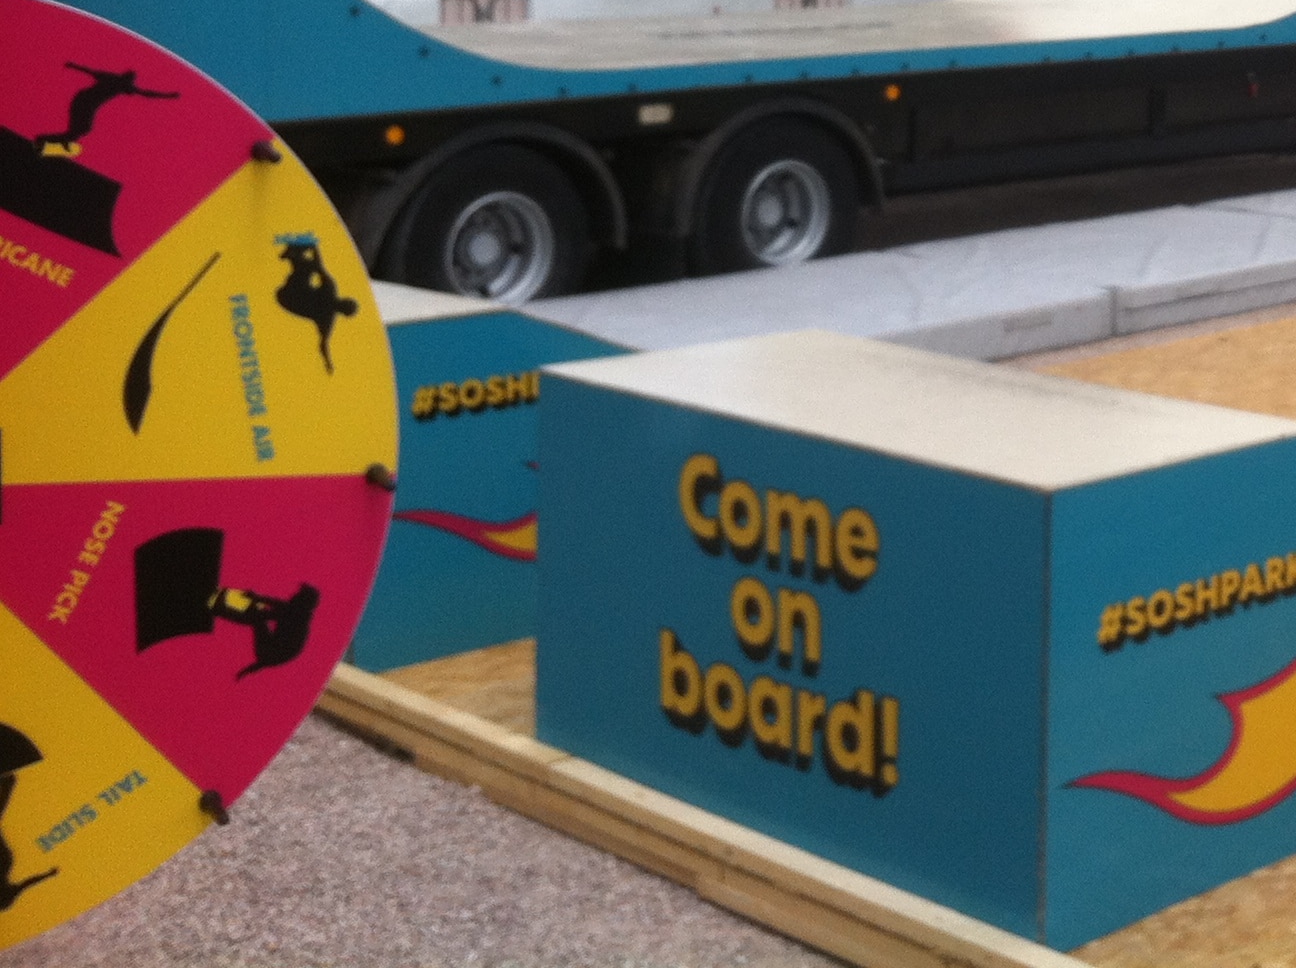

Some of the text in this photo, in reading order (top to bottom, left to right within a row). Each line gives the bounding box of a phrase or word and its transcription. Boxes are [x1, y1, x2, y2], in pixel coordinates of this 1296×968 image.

[0, 235, 75, 288] ICANE
[229, 293, 275, 462] FRONTSIDE AIR
[48, 500, 125, 625] NOSE PICK
[678, 452, 881, 583] Come
[730, 575, 824, 667] on
[659, 627, 900, 790] board!
[36, 769, 148, 852] TAIL SLIDE
